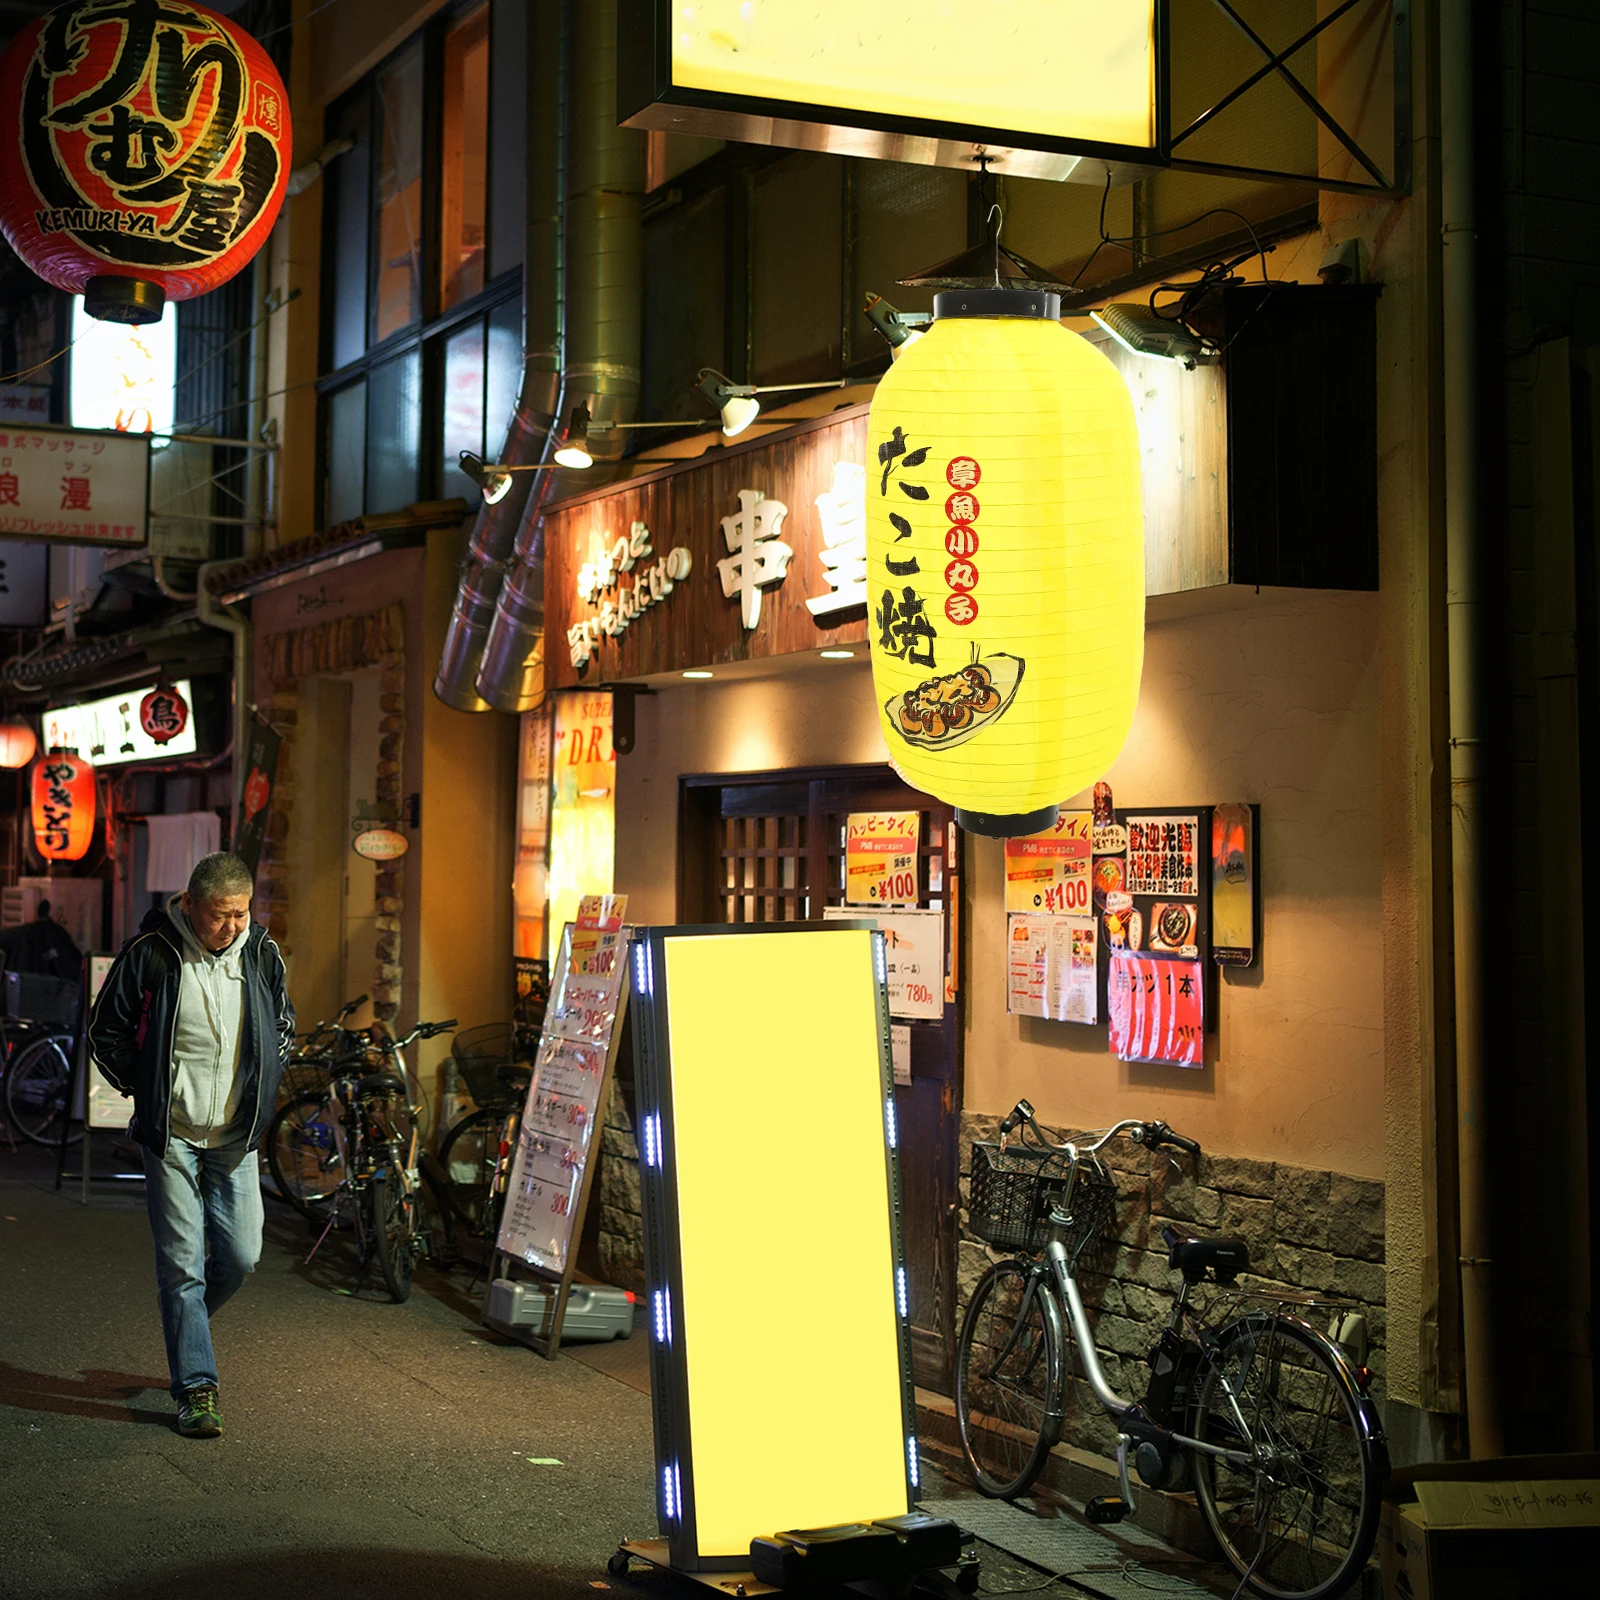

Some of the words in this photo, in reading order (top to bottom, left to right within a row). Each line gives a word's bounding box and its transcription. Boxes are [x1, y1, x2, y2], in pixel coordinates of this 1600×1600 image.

[35, 209, 156, 236] KEMURI-YA
[876, 425, 938, 669] たこ焼
[947, 459, 977, 623] 章魚小丸子
[878, 872, 915, 901] ¥100
[1044, 879, 1089, 911] ¥100
[906, 983, 933, 1004] 780円
